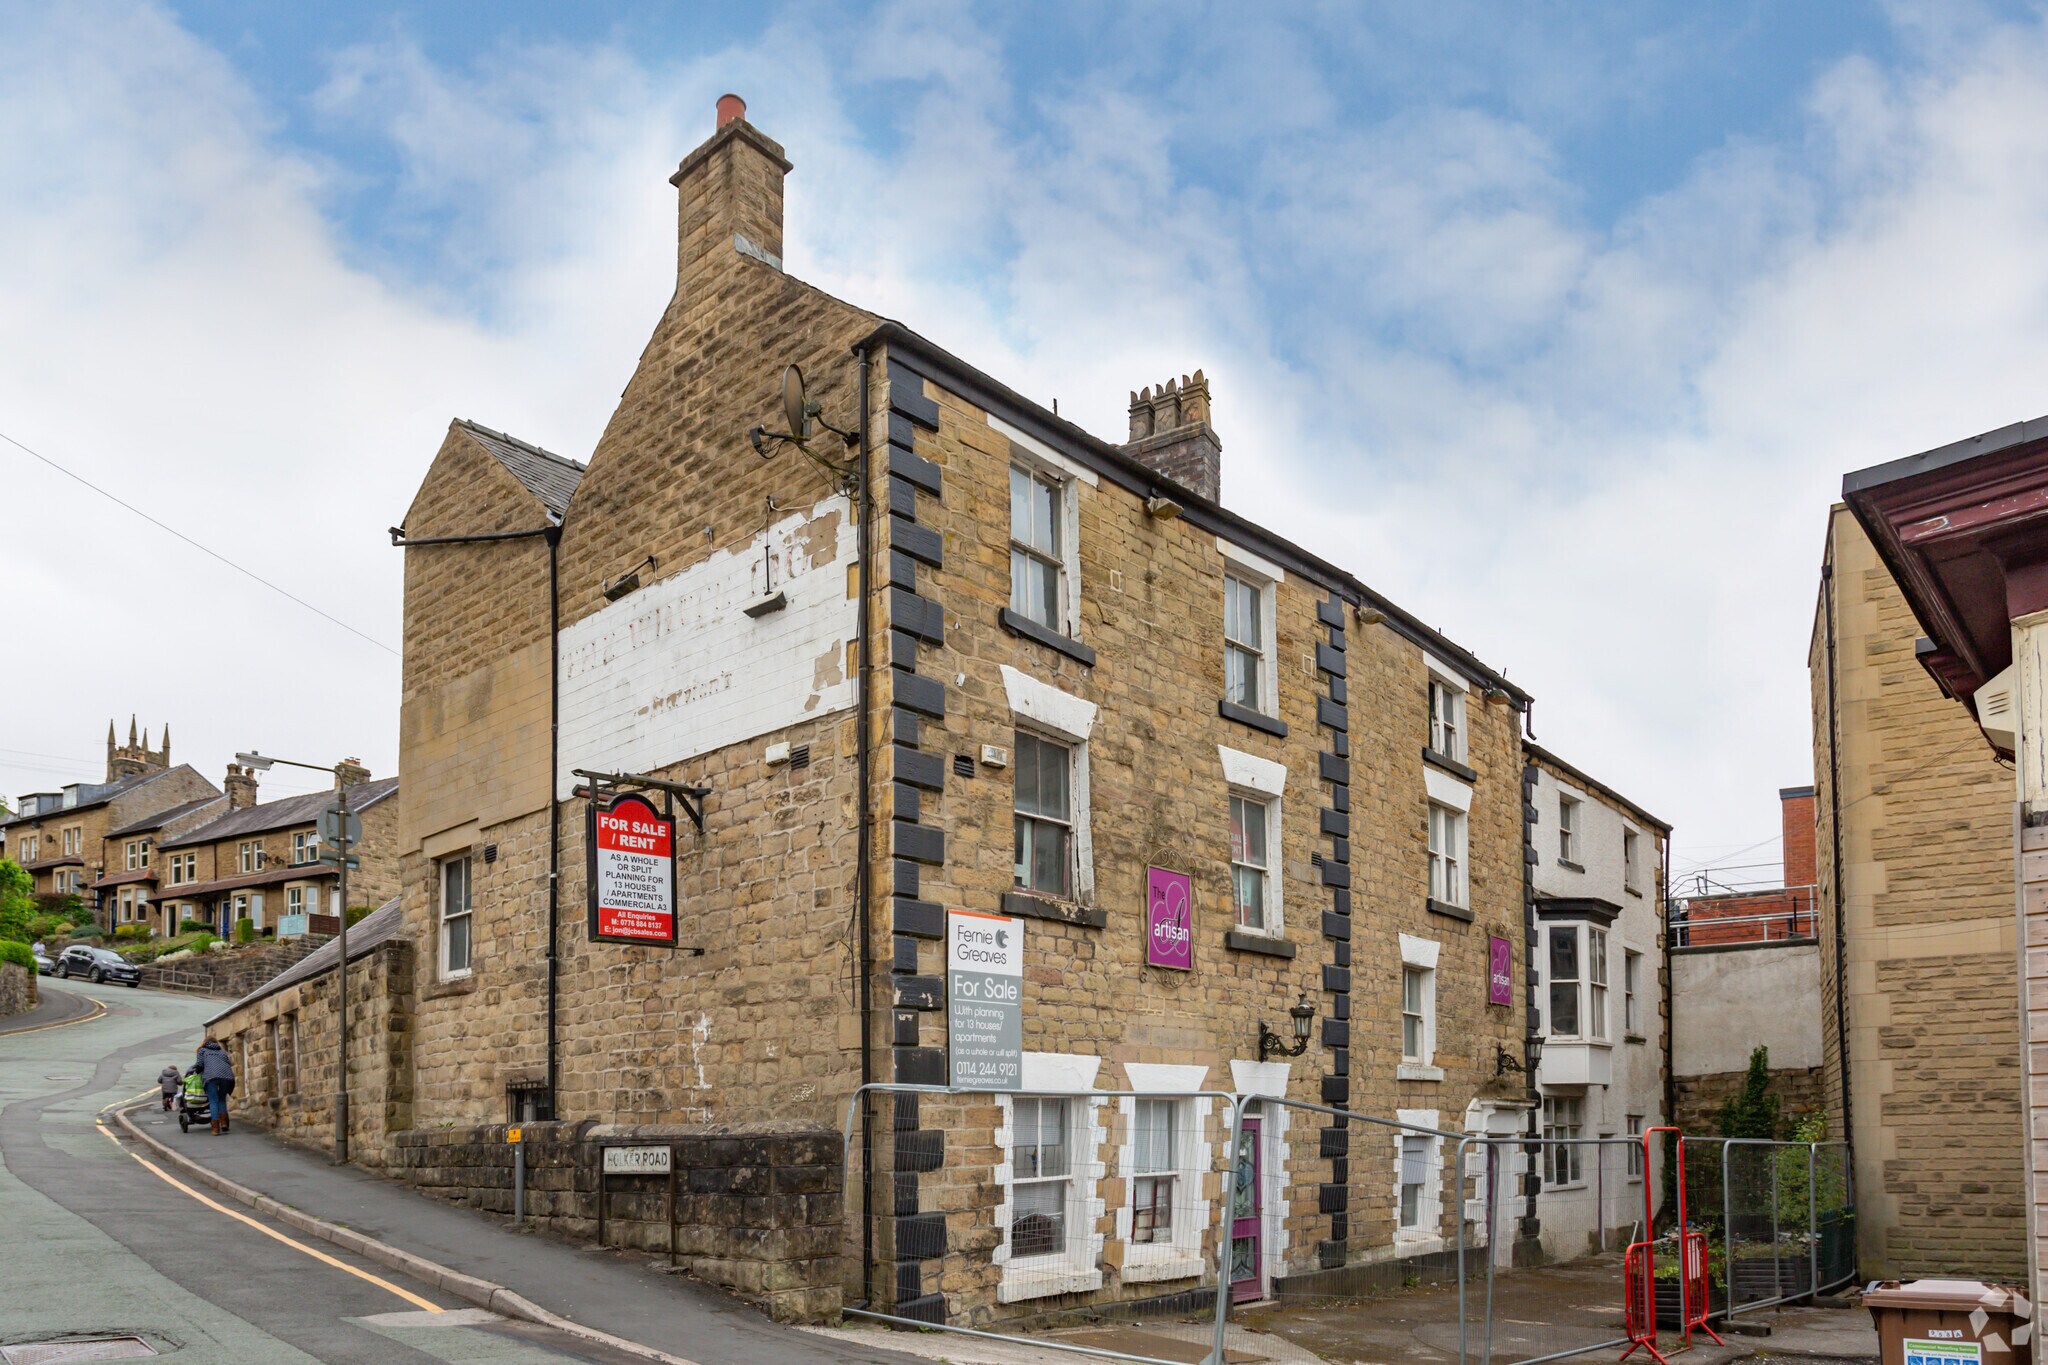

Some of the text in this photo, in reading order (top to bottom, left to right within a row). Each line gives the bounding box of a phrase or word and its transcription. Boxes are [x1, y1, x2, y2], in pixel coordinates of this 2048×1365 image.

[601, 816, 666, 837] FOR SALE
[612, 833, 656, 850] / RENT
[630, 856, 659, 866] WHOLE
[617, 863, 652, 874] OR SPLIT
[606, 871, 664, 884] PLANNING FOR
[624, 882, 656, 892] HOUSES
[1153, 886, 1165, 900] The
[611, 890, 663, 902] APARTMENTS
[603, 898, 656, 910] COMMERCIAL
[611, 918, 619, 926] M:
[627, 912, 656, 920] Enquiries
[958, 924, 993, 945] Fernie
[1154, 921, 1189, 942] artisan
[957, 943, 1007, 965] Greaves
[954, 974, 1018, 1000] For Sale
[954, 1005, 1004, 1020] With planning
[954, 1018, 1003, 1031] for 13 houses/
[955, 1033, 997, 1044] apartments
[955, 1046, 964, 1055] (as
[971, 1048, 988, 1056] whole
[956, 1061, 1017, 1076] 0114 244 9121
[956, 1076, 1008, 1085] ferniegreaves.co.uk
[642, 1152, 668, 1166] ROAD
